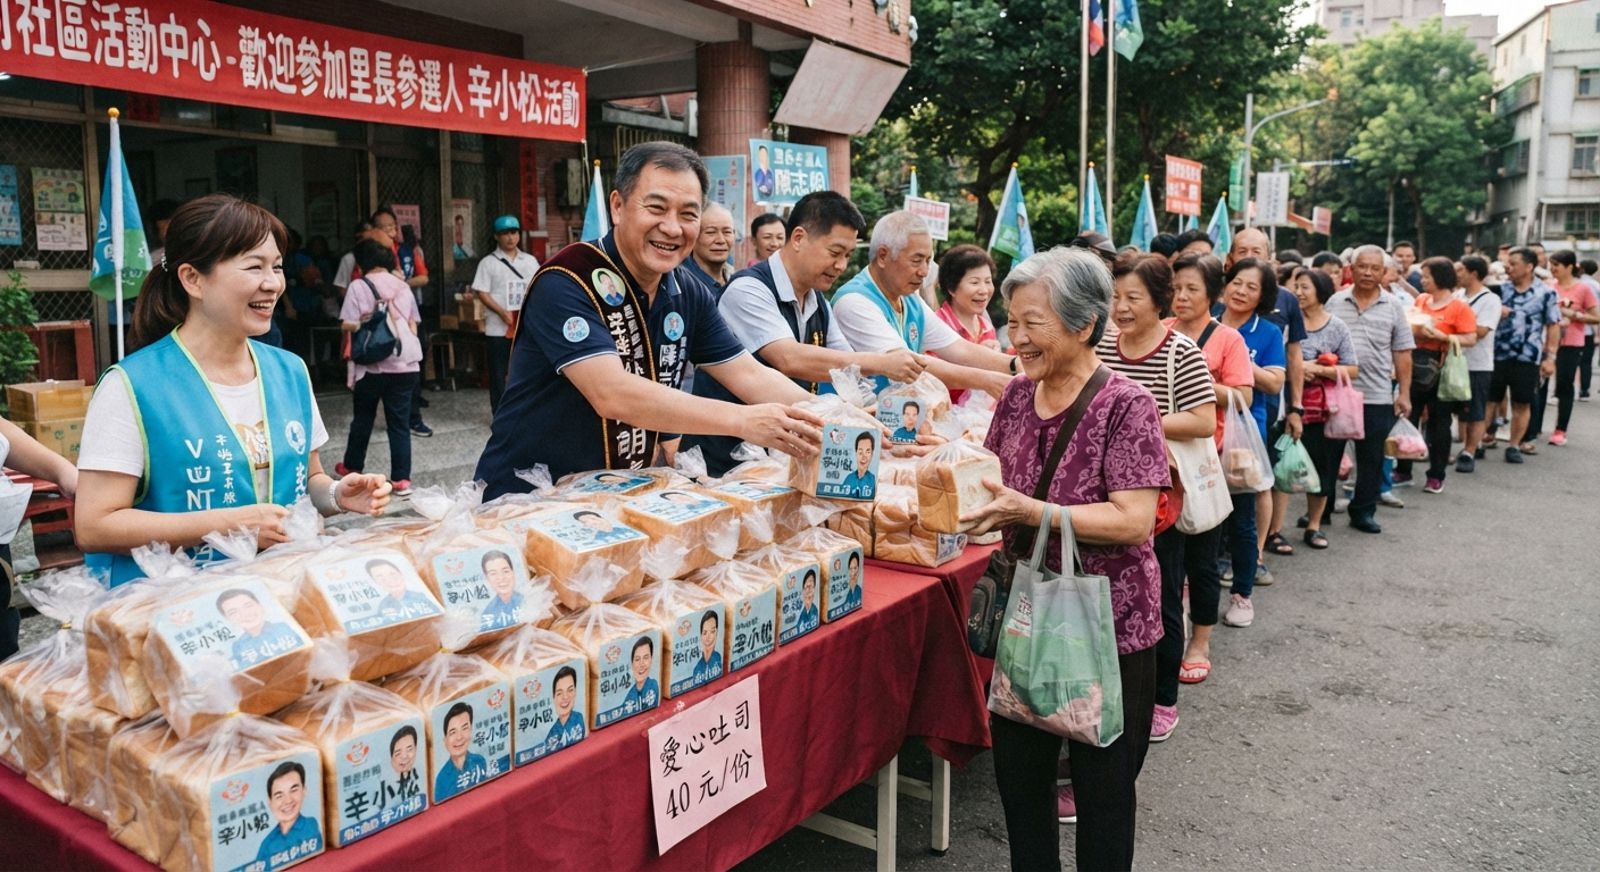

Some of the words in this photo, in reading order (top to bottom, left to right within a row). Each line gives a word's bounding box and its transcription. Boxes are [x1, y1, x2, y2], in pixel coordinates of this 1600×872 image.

[660, 700, 749, 777] 愛心吐司
[666, 782, 691, 819] 40
[699, 749, 752, 804] 元/份
